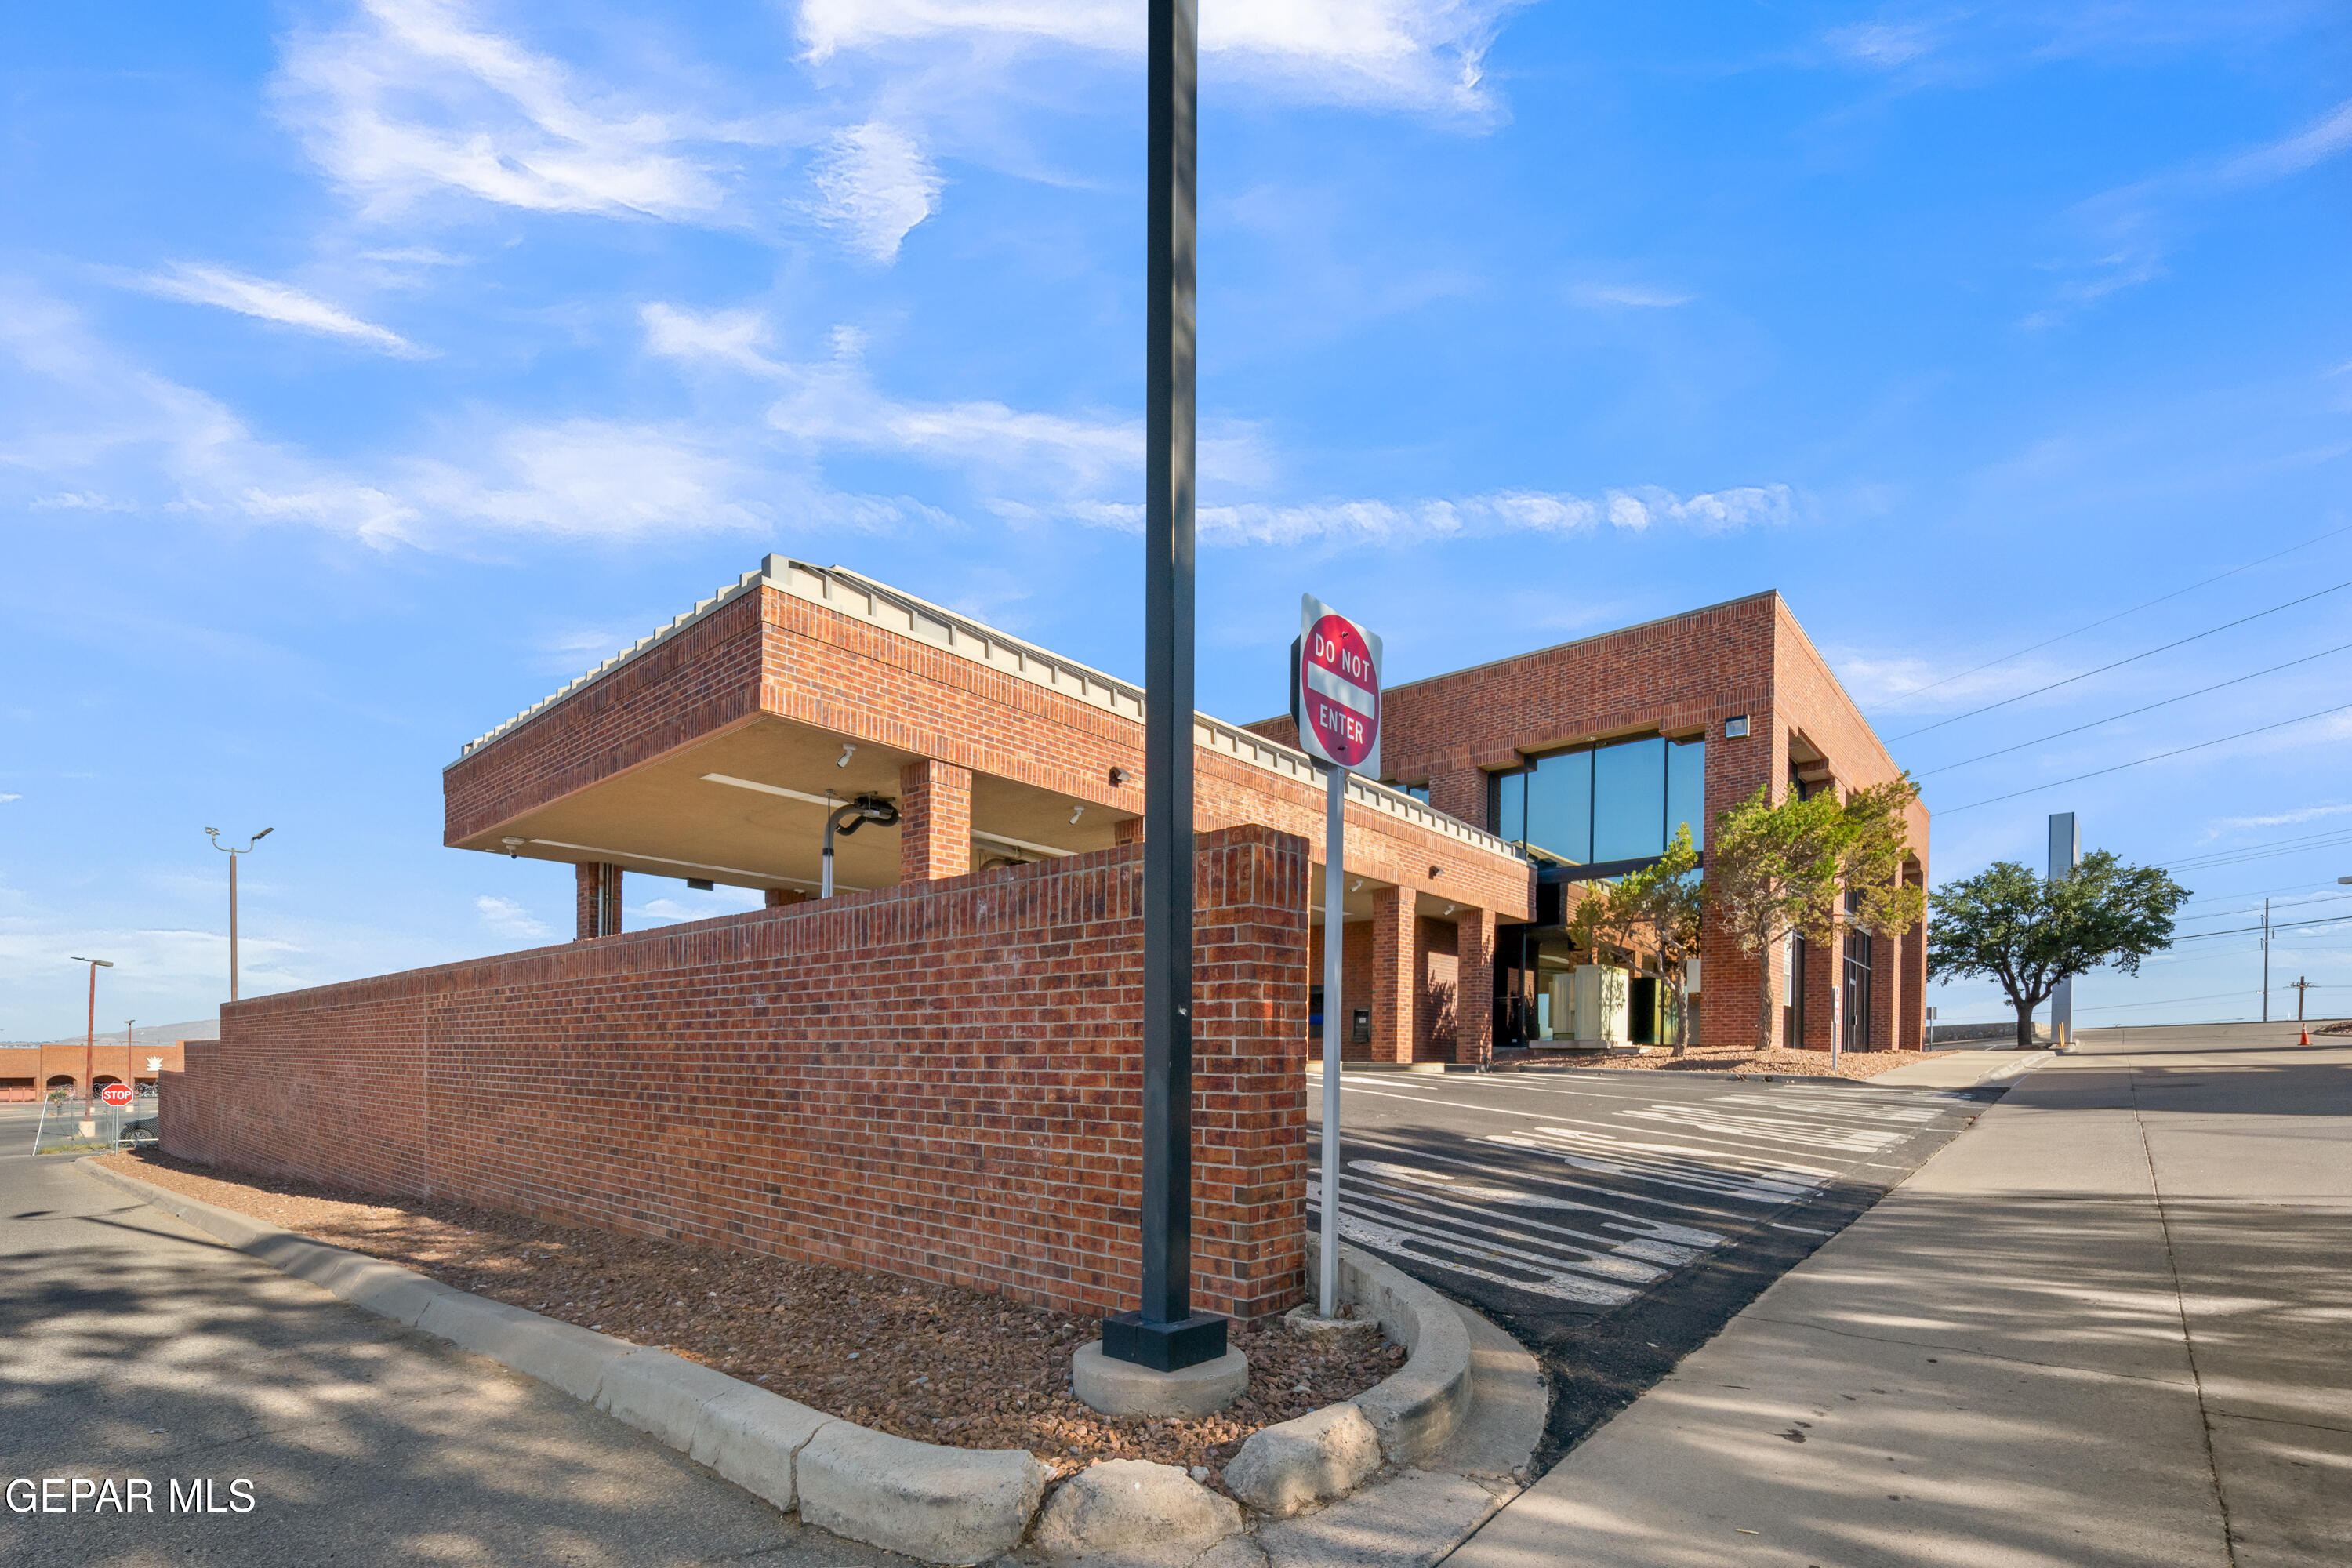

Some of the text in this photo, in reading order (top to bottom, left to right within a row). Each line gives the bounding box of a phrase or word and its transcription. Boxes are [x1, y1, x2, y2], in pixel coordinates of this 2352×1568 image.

[1315, 633, 1370, 682] DO NOT
[1319, 703, 1363, 744] ENTER
[103, 1091, 132, 1100] STOP
